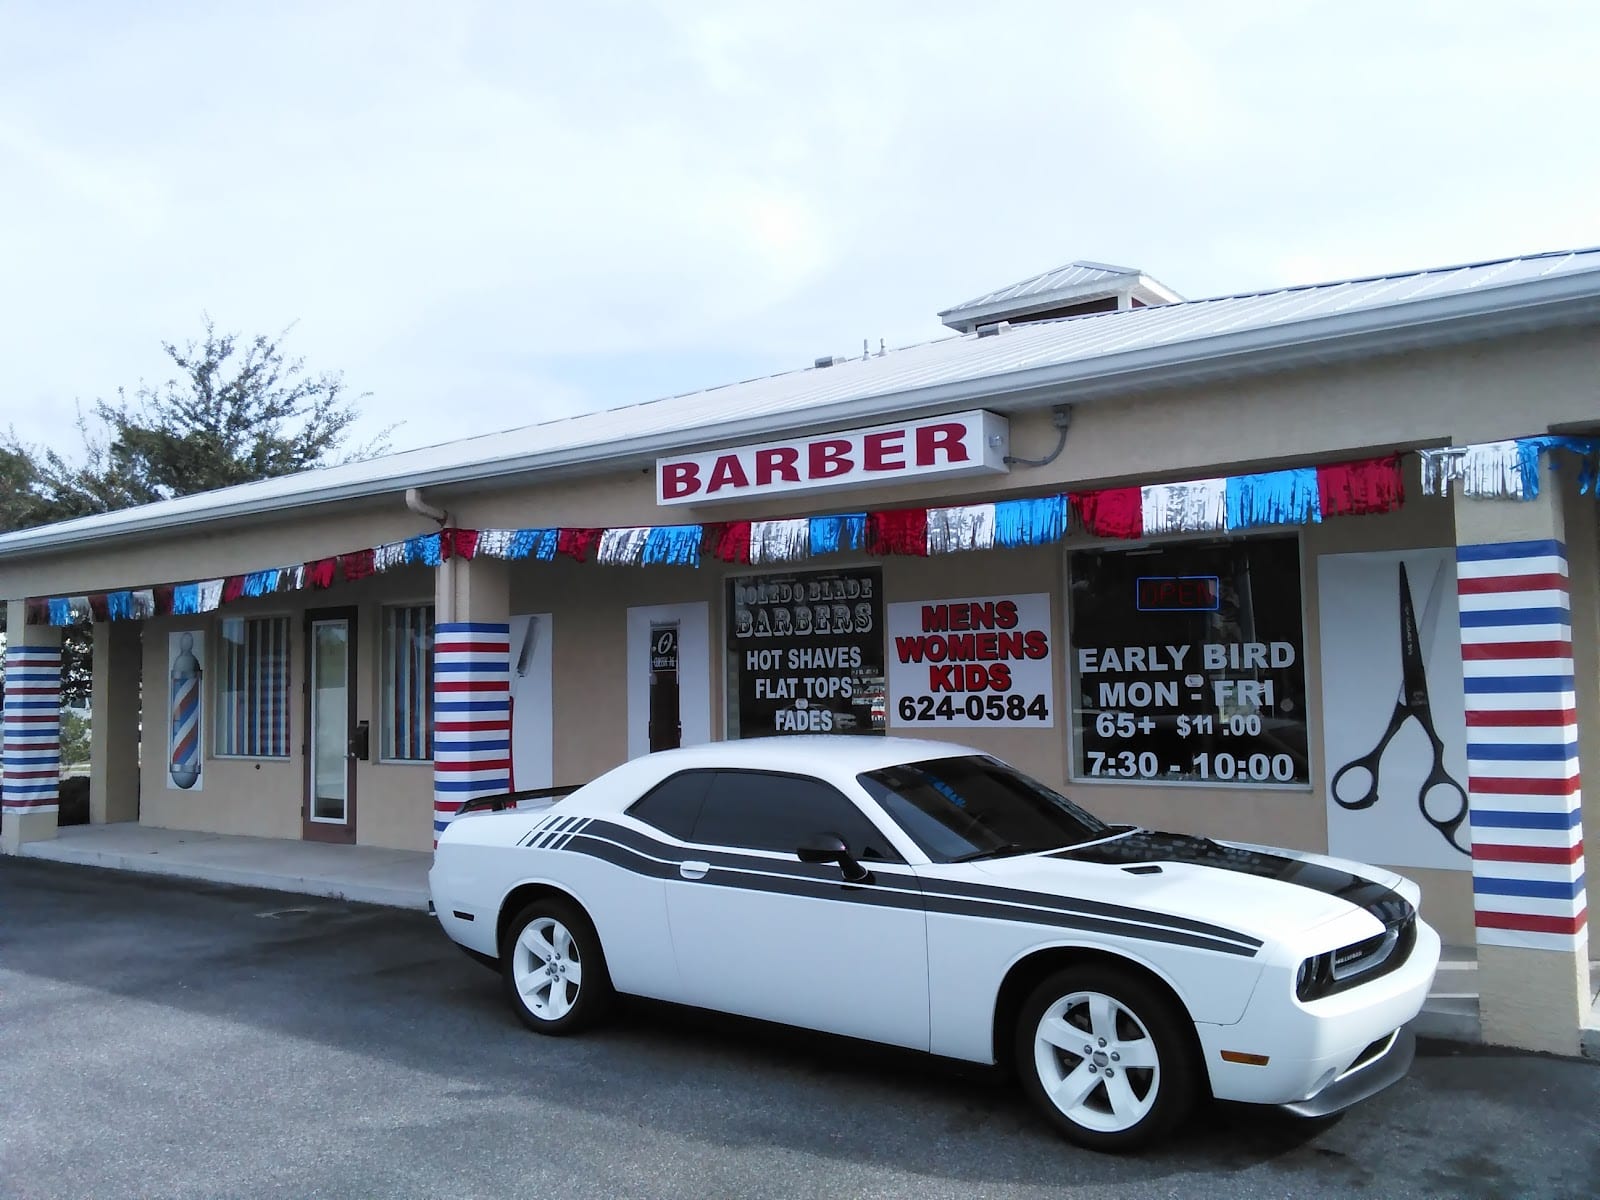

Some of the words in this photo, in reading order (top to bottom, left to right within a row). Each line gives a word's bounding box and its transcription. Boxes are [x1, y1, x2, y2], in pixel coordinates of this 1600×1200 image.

[663, 423, 971, 499] BARBER
[735, 582, 805, 606] TOLEDO
[808, 578, 873, 602] BLADE
[1142, 581, 1216, 606] OPEN
[735, 602, 873, 638] BARBERS
[921, 600, 1019, 632] MENS
[747, 649, 783, 671] HOT
[788, 646, 862, 670] SHAVES
[895, 630, 1049, 663] WOMENS
[1078, 645, 1191, 673] EARLY
[1203, 642, 1296, 670] BIRD
[755, 677, 799, 699] FLAT
[803, 677, 853, 699] TOPS
[929, 663, 1012, 693] KIDS
[898, 694, 1049, 721] 624-0584
[1099, 681, 1179, 707] MON
[1214, 680, 1275, 706] FRI
[775, 709, 833, 731] FADES
[1096, 713, 1156, 738] 65+
[1087, 751, 1159, 777] 7:30
[1193, 752, 1295, 782] 10:00
